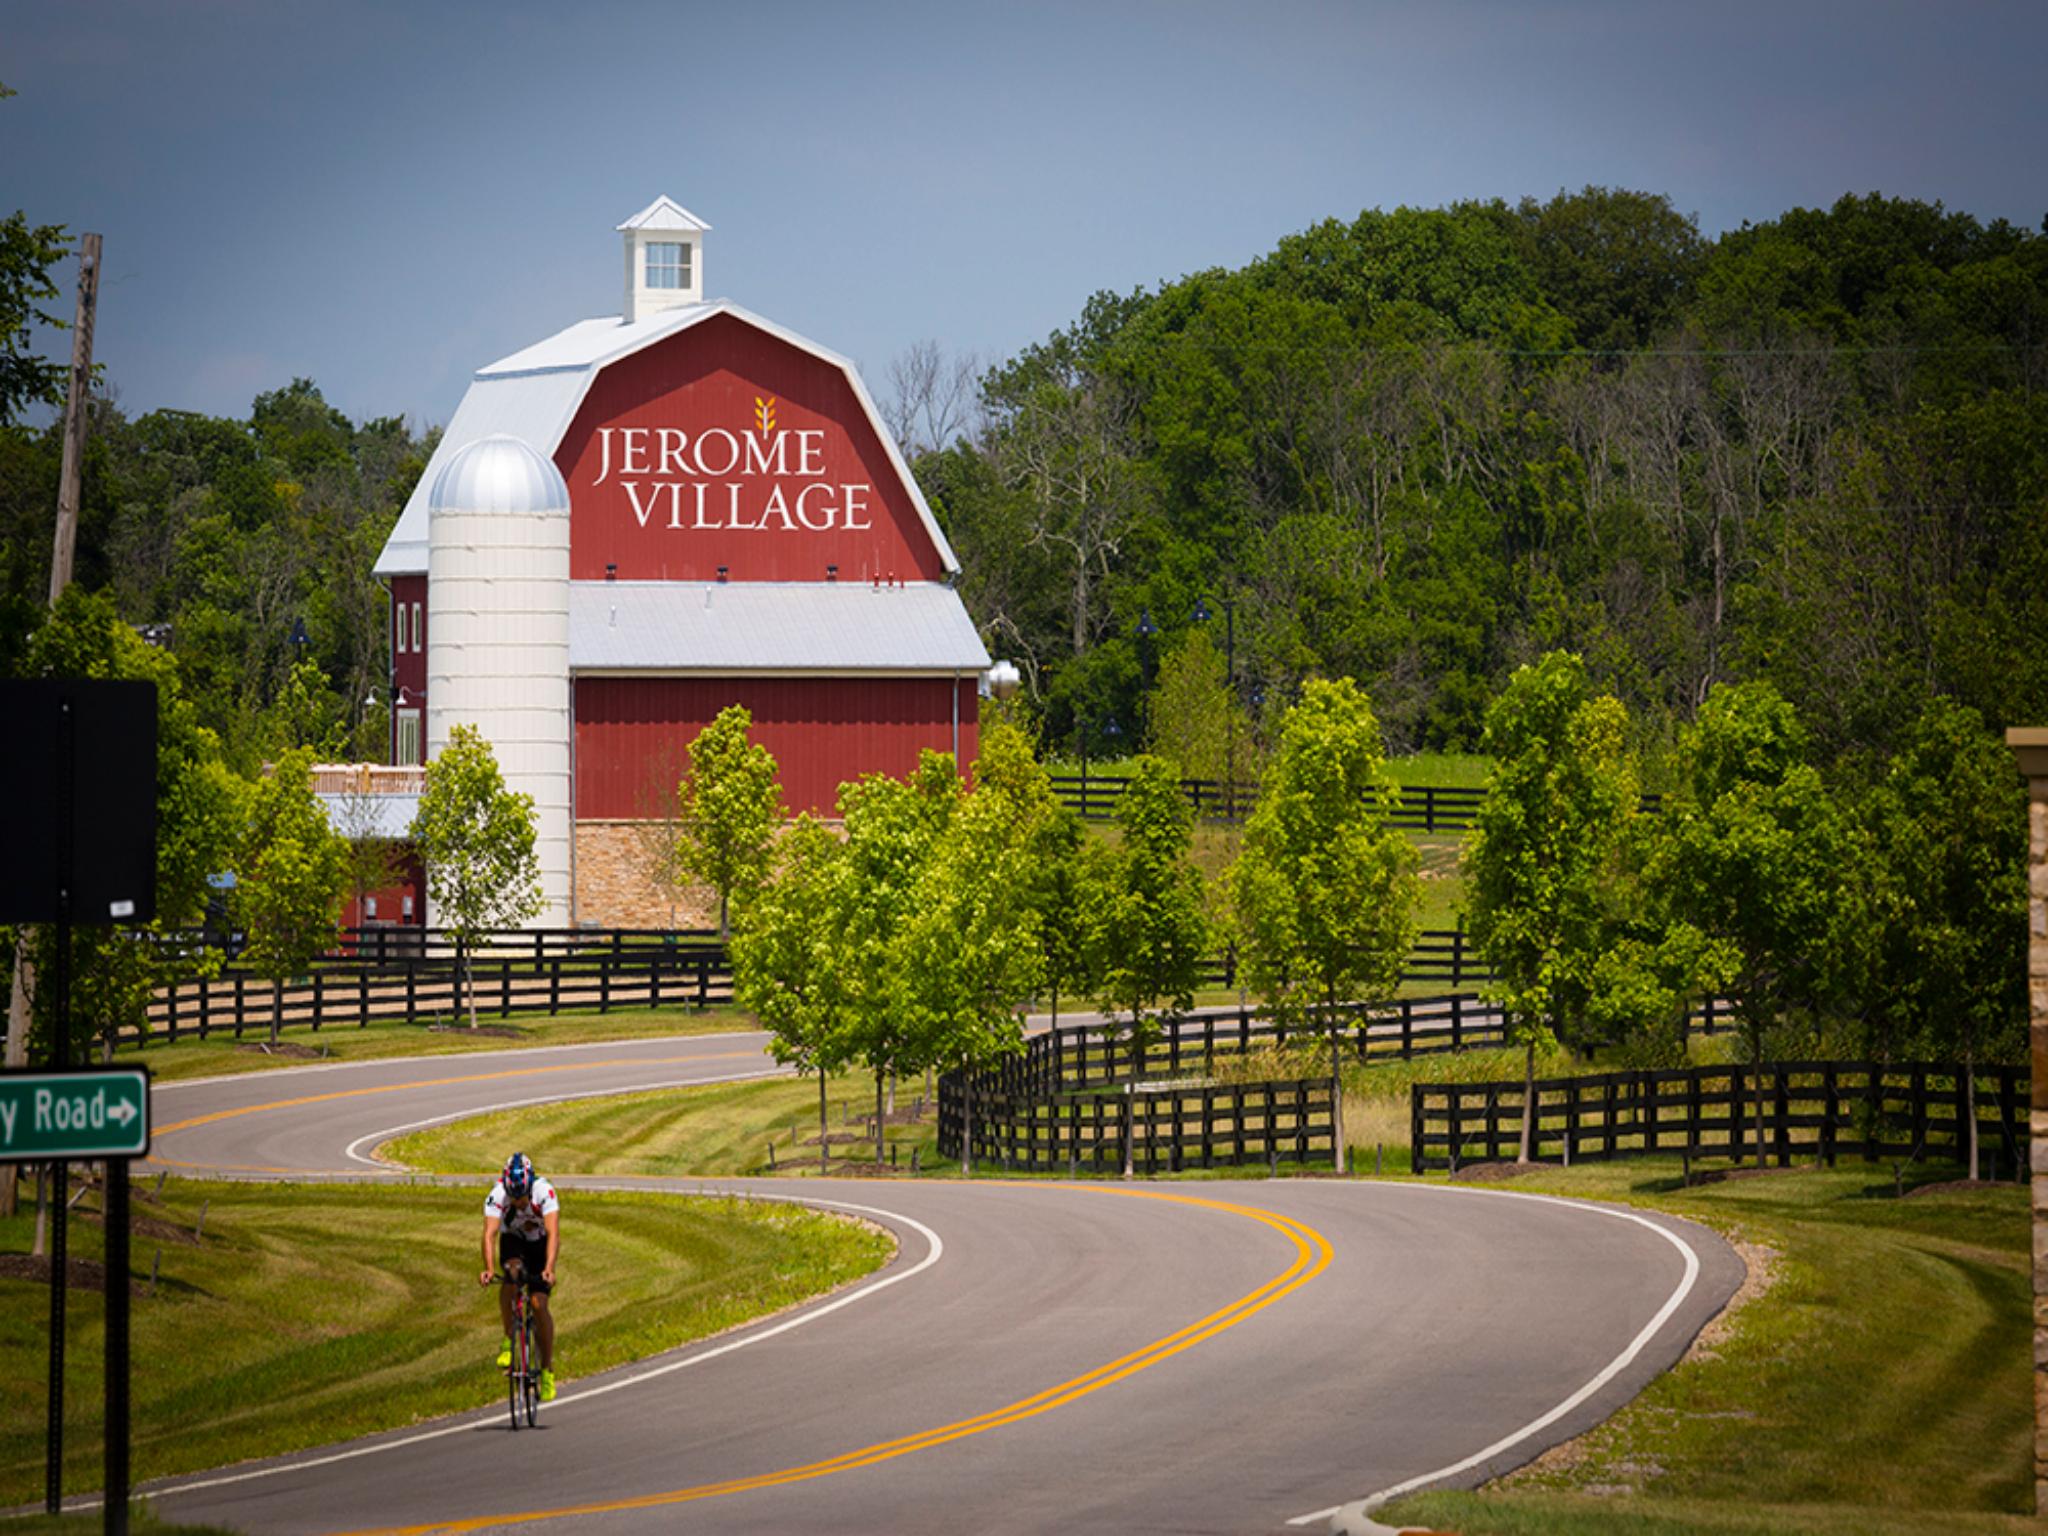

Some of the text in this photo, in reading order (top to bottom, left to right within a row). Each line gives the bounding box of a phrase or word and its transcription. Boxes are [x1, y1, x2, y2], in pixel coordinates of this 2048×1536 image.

[592, 427, 826, 486] JEROME
[620, 481, 872, 531] VILLAGE
[34, 1086, 105, 1132] Road
